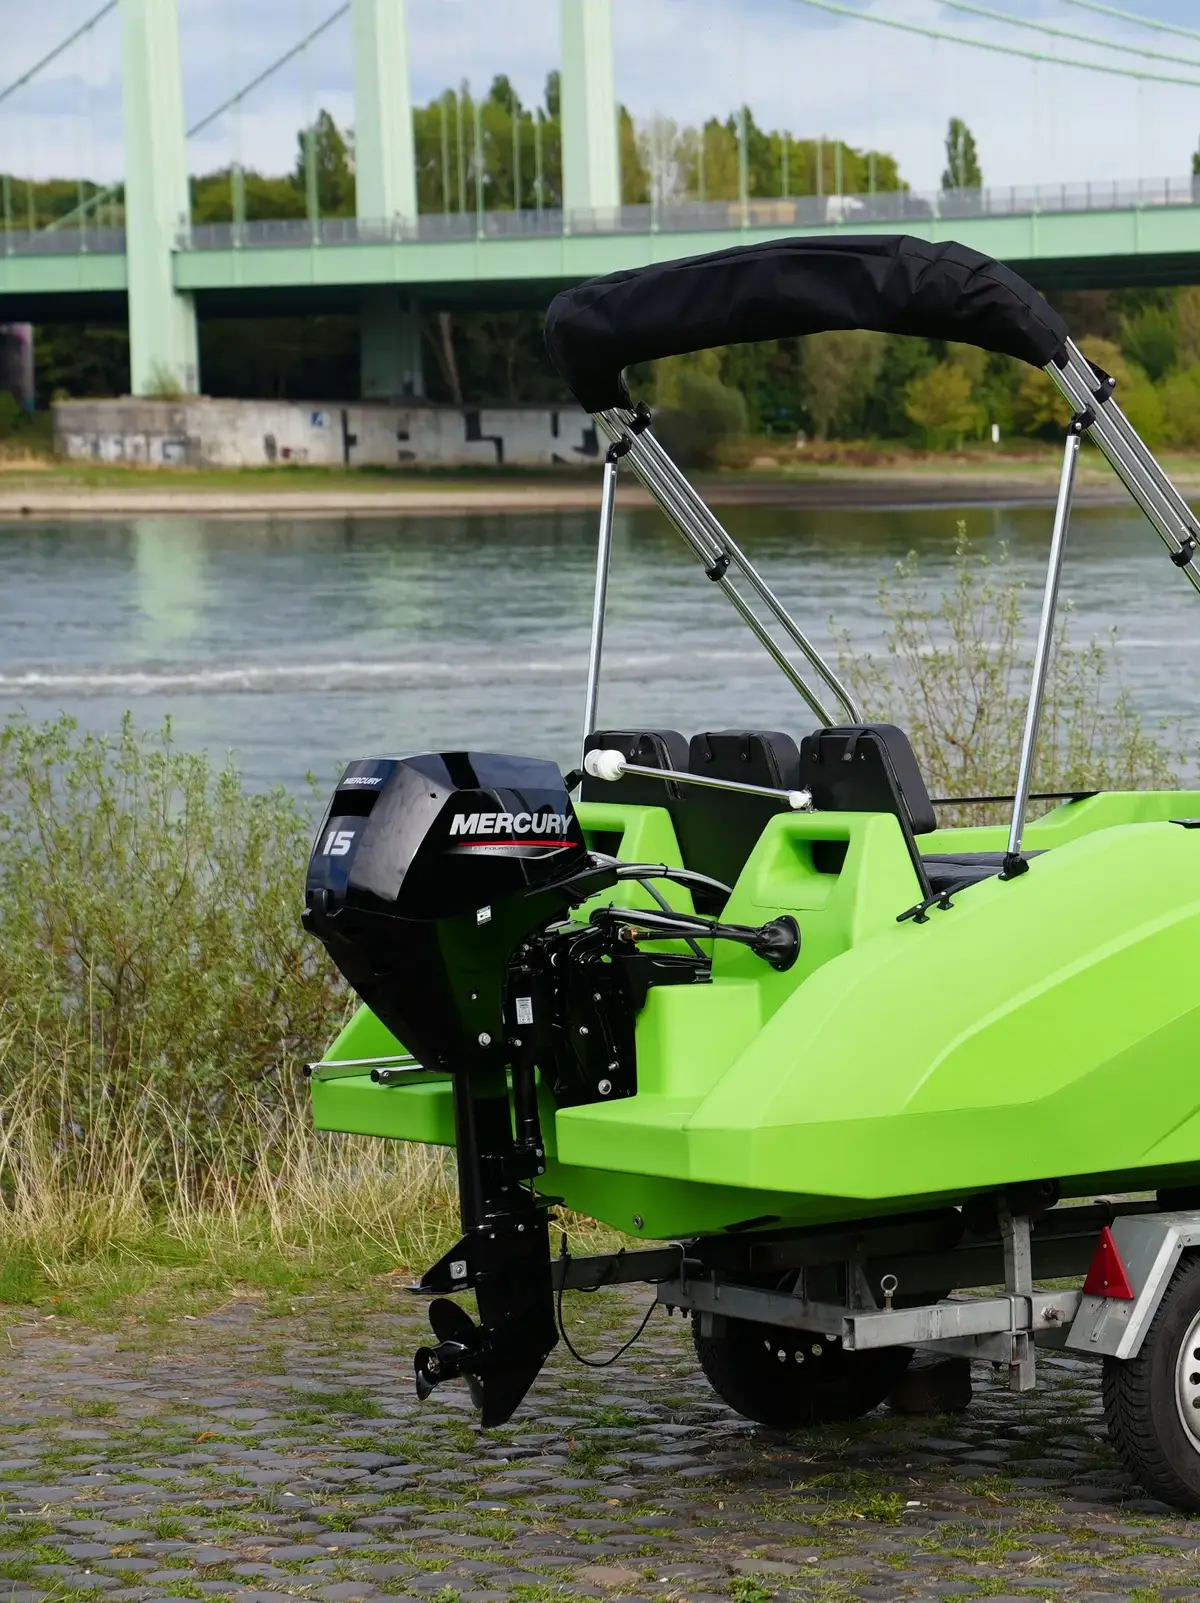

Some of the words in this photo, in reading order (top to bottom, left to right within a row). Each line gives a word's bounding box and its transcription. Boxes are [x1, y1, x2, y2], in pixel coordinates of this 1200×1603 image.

[343, 777, 383, 785] MERCURY
[449, 812, 573, 835] MERCURY
[322, 831, 356, 855] 15
